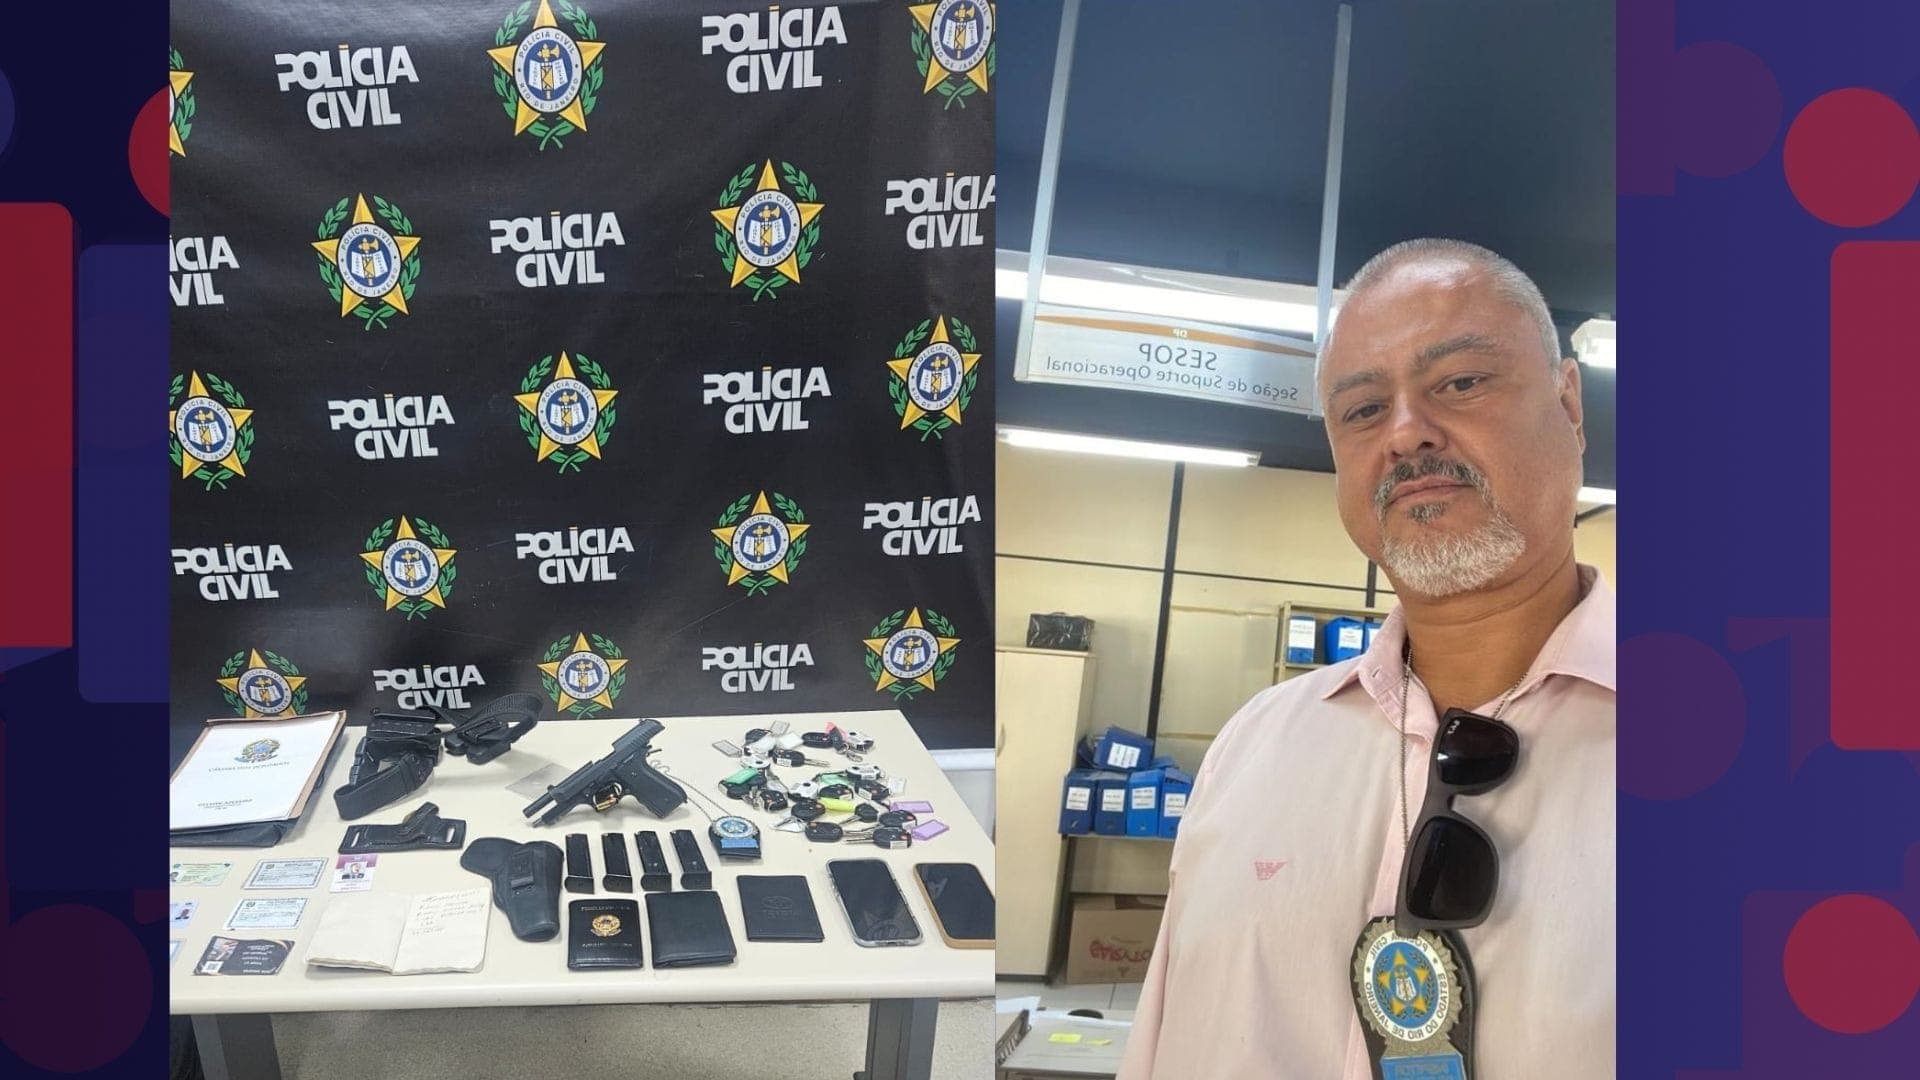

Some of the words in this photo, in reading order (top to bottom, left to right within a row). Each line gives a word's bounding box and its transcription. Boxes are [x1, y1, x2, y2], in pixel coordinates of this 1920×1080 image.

[554, 32, 575, 54] CIVIL
[702, 5, 847, 54] POLÍCIA
[275, 44, 419, 91] POLÍCIA
[727, 50, 822, 93] CIVIL
[307, 88, 401, 129] CIVIL
[776, 194, 795, 216] CIVIL
[885, 172, 996, 215] POLÍCIA
[372, 228, 393, 247] CIVIL
[490, 211, 626, 253] POLÍCIA
[907, 213, 984, 249] CIVIL
[516, 250, 604, 287] CIVIL
[704, 366, 831, 404] POLÍCIA
[328, 394, 455, 430] POLÍCIA
[725, 401, 808, 433] CIVIL
[355, 427, 438, 460] CIVIL
[863, 495, 981, 529] POLÍCIA
[515, 526, 634, 559] POLÍCIA
[883, 527, 962, 556] CIVIL
[172, 543, 293, 575] POLÍCIA
[539, 556, 616, 585] CIVIL
[200, 574, 279, 601] CIVIL
[703, 642, 814, 670] POLÍCIA
[373, 664, 486, 691] POLÍCIA
[721, 669, 795, 693] CIVIL
[398, 688, 471, 710] CIVIL
